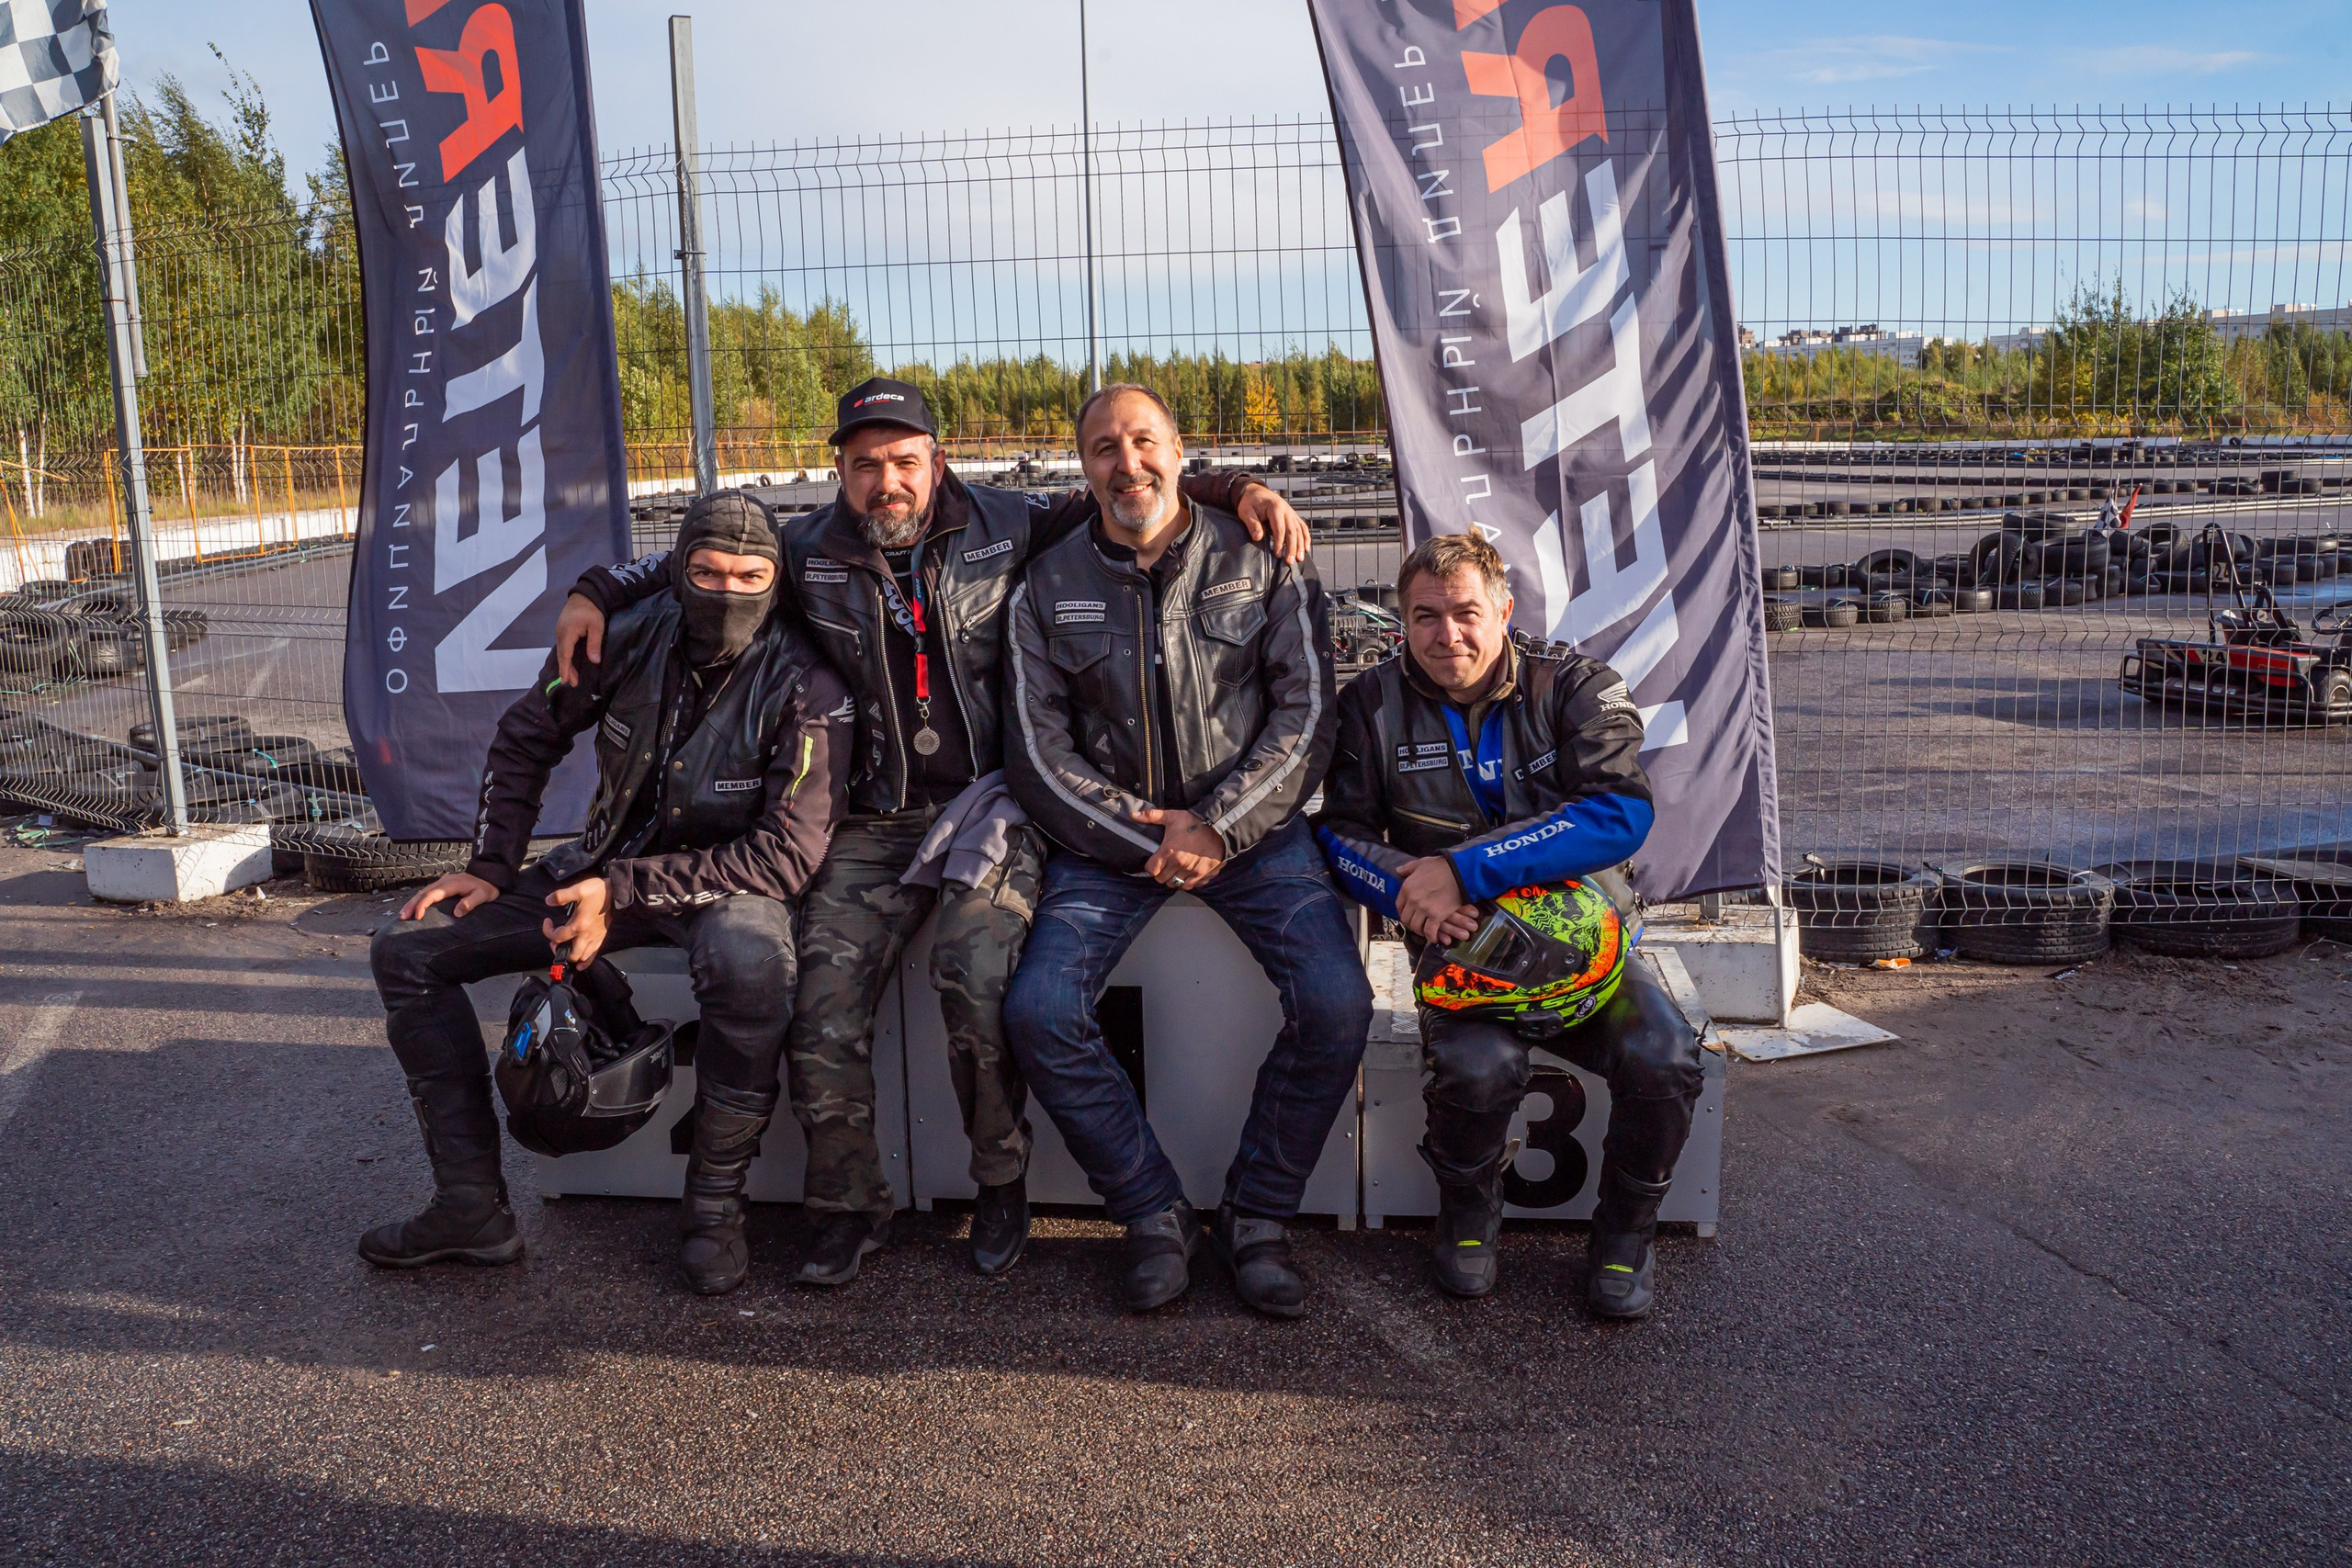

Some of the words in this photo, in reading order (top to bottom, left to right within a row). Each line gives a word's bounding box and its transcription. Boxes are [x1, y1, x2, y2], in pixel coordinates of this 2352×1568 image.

[865, 392, 904, 402] ardeca
[967, 542, 1011, 560] MEMBER
[1204, 580, 1248, 597] MEMBER
[2201, 649, 2225, 664] 24
[717, 779, 760, 791] MEMBER
[1484, 819, 1577, 859] HONDA
[1337, 855, 1386, 894] HONDA
[1503, 1065, 1588, 1209] 3
